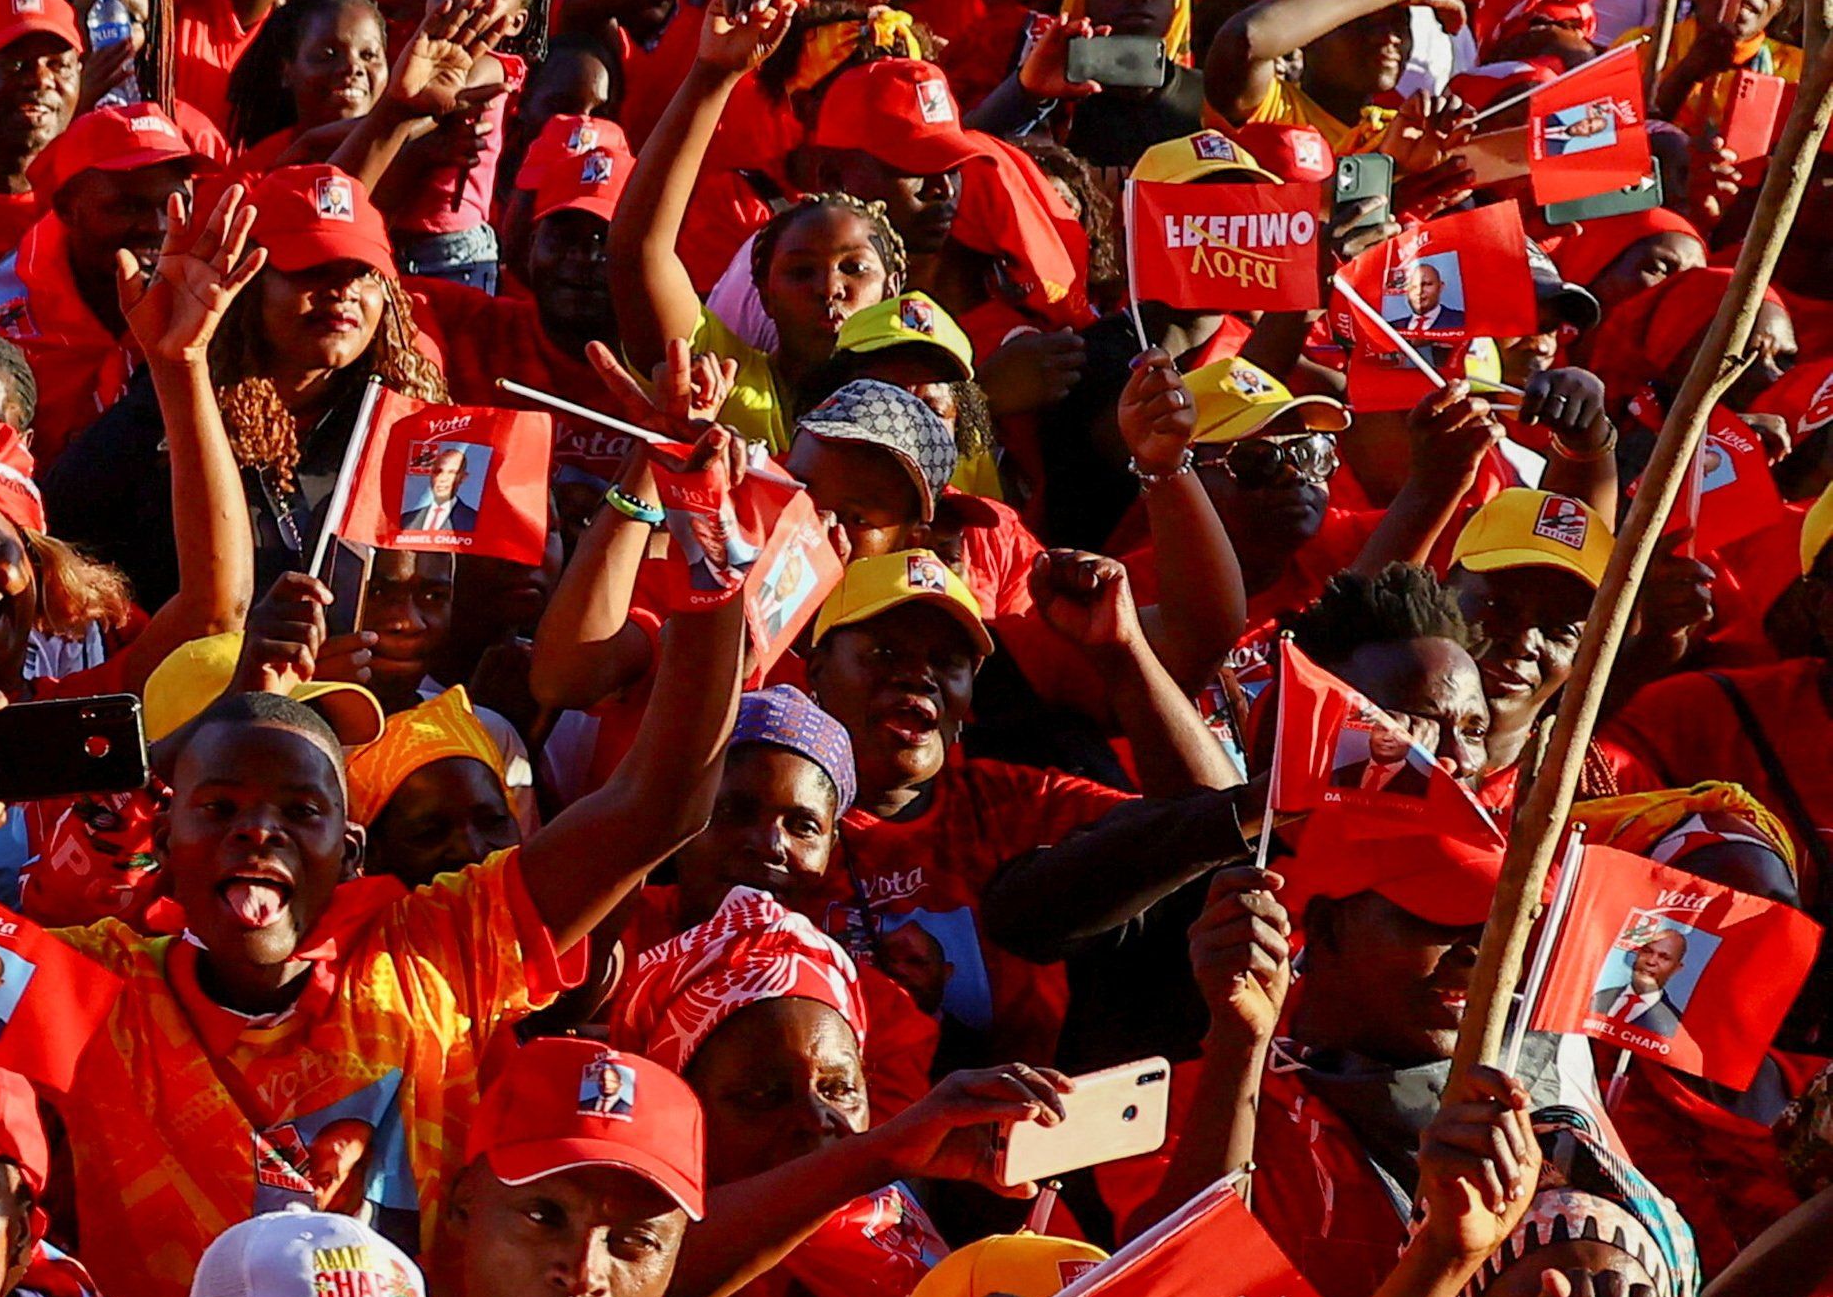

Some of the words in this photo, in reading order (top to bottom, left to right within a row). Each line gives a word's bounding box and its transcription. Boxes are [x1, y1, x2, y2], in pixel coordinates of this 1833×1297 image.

[428, 412, 472, 436] Vota
[554, 422, 631, 454] Vota
[1717, 426, 1755, 454] Vota
[396, 534, 433, 546] DANIEL
[435, 534, 473, 546] CHAPO
[862, 866, 923, 899] Vota
[1655, 888, 1710, 911] Vota
[1621, 1030, 1671, 1056] CHAPO
